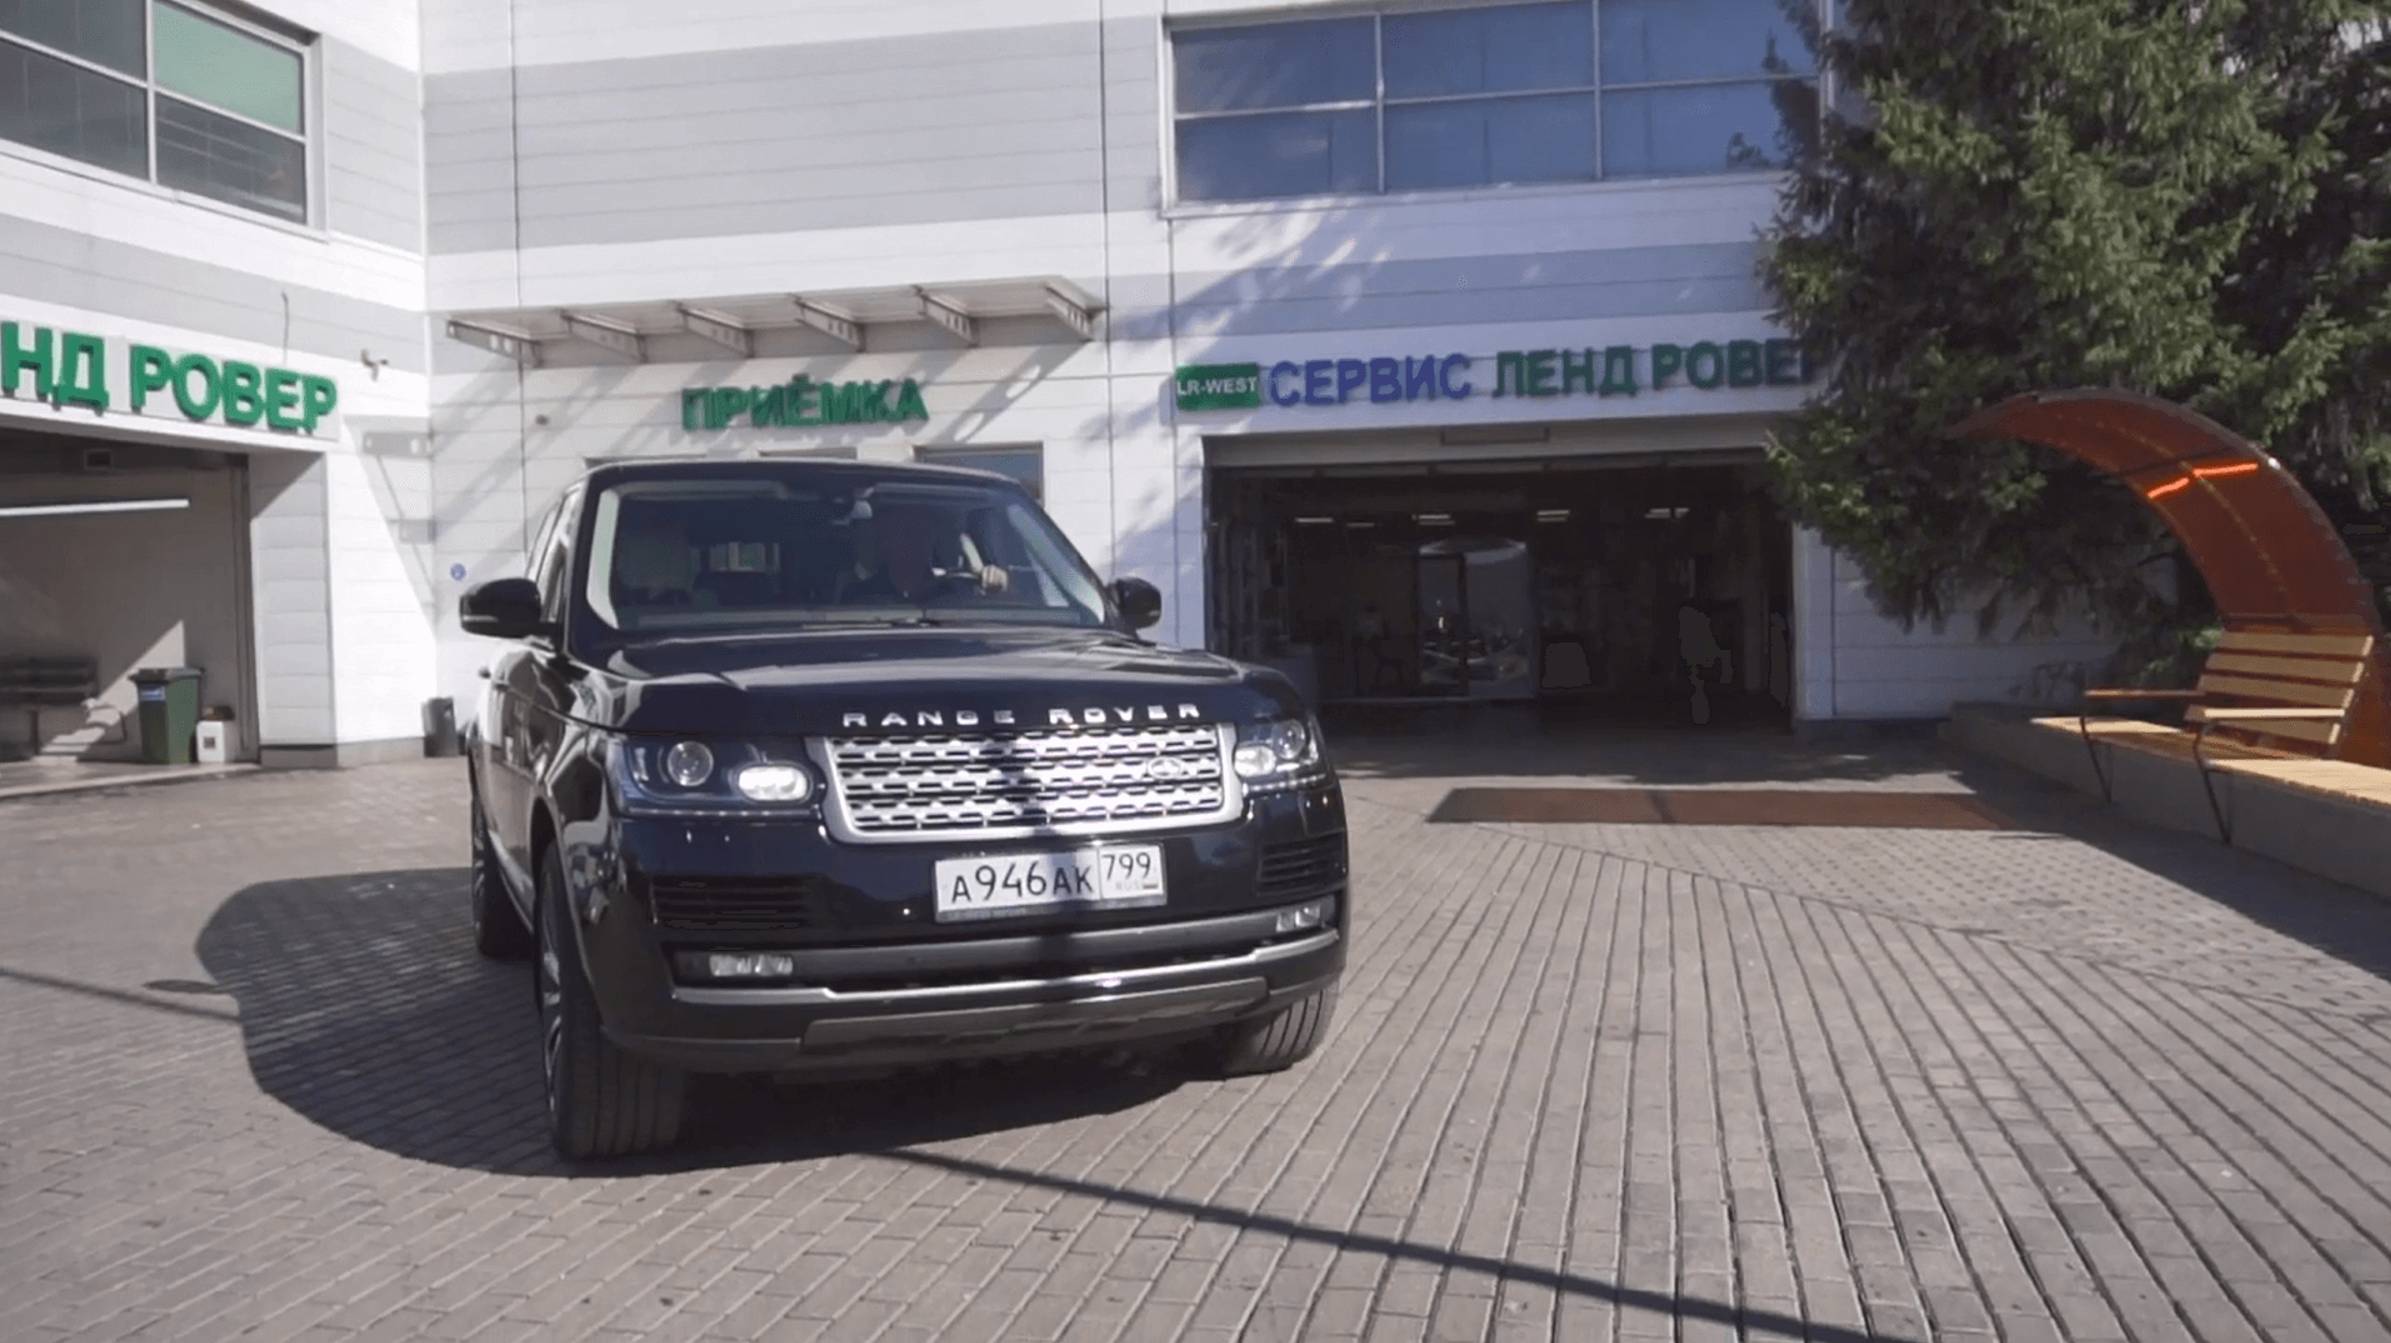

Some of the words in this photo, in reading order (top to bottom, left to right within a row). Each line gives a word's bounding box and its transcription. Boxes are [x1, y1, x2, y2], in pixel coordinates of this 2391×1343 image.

[129, 343, 337, 436] РОВЕР
[1176, 377, 1257, 396] LR-WEST
[1270, 353, 1472, 407] СЕРВИС
[1492, 345, 1637, 397] ЛЕНД
[682, 373, 930, 432] ПРИЁМКА
[843, 710, 1016, 727] RANGE
[1048, 703, 1200, 724] ROVER
[1101, 852, 1151, 881] 799
